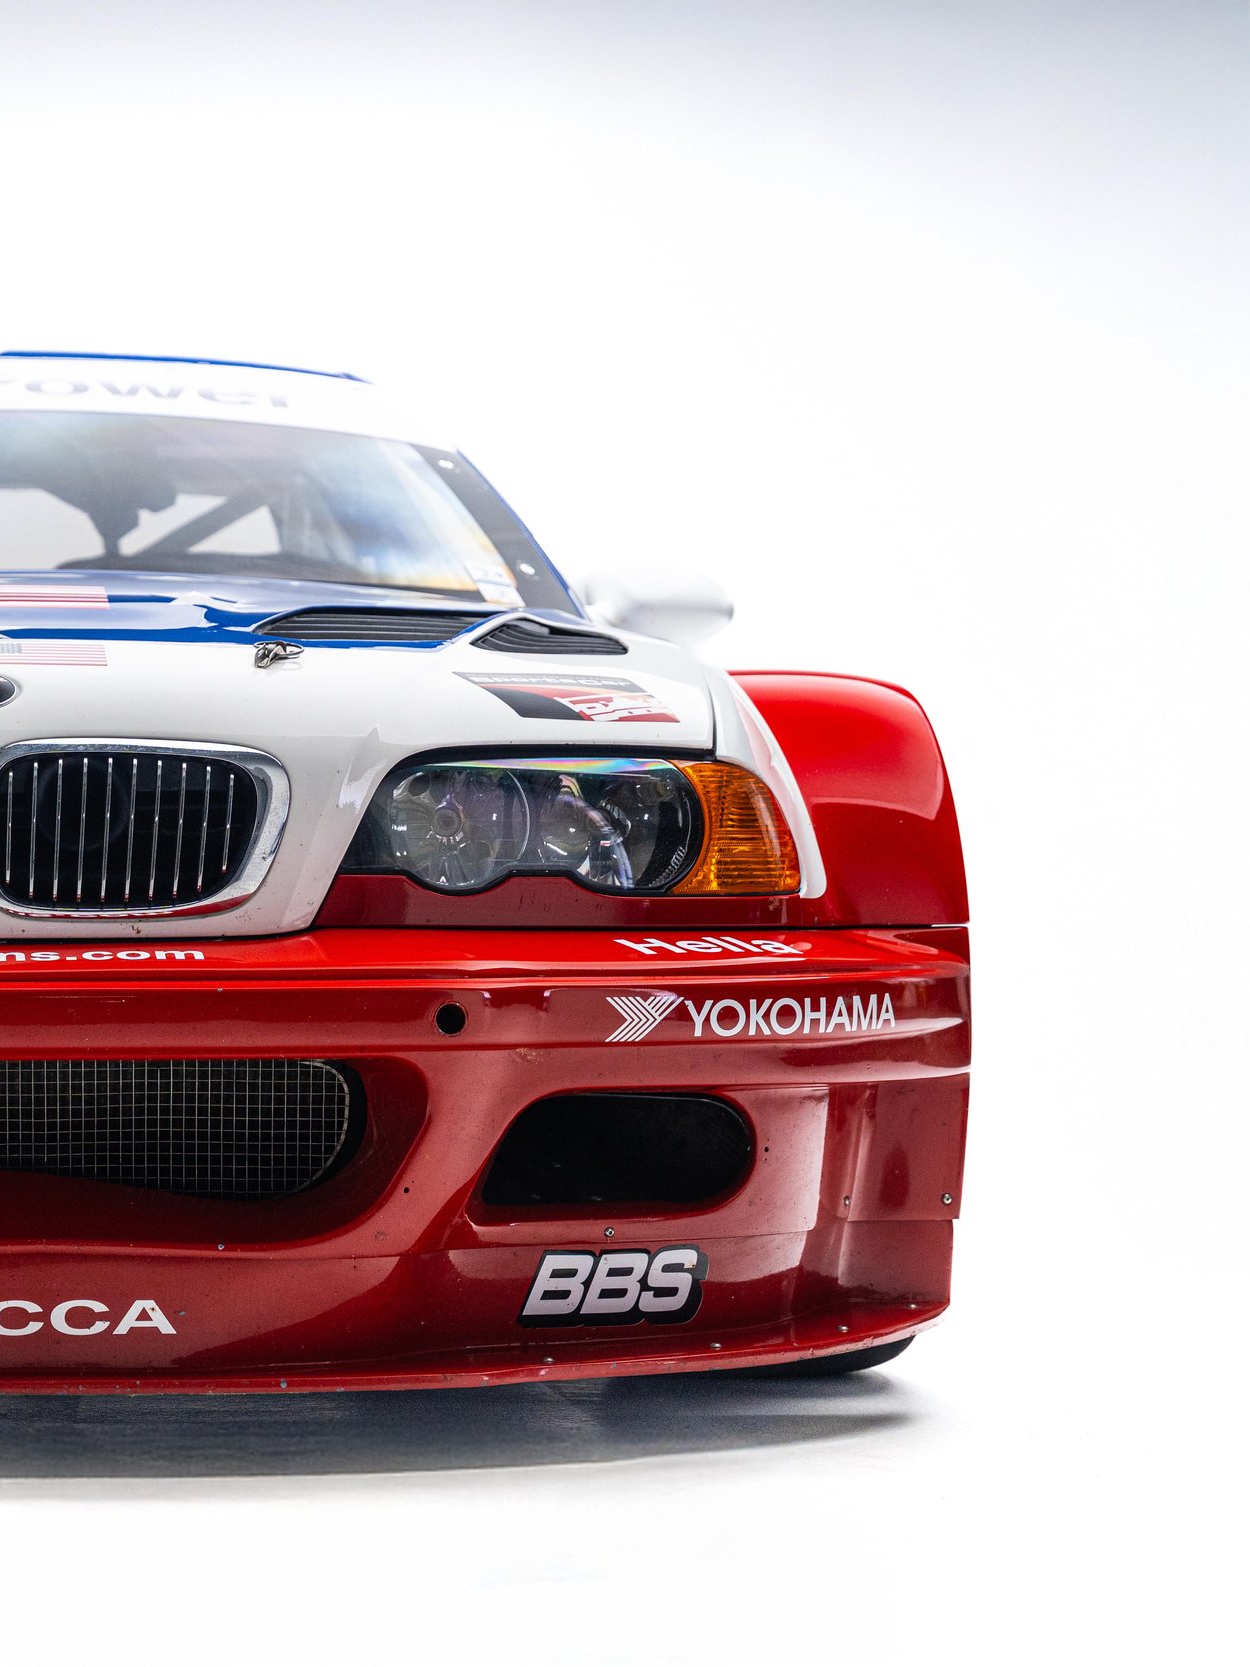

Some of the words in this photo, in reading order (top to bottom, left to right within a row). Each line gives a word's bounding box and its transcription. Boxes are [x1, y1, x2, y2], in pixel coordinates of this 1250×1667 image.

[615, 936, 804, 954] Hella
[684, 994, 896, 1037] YOKOHAMA
[522, 1249, 698, 1315] BBS
